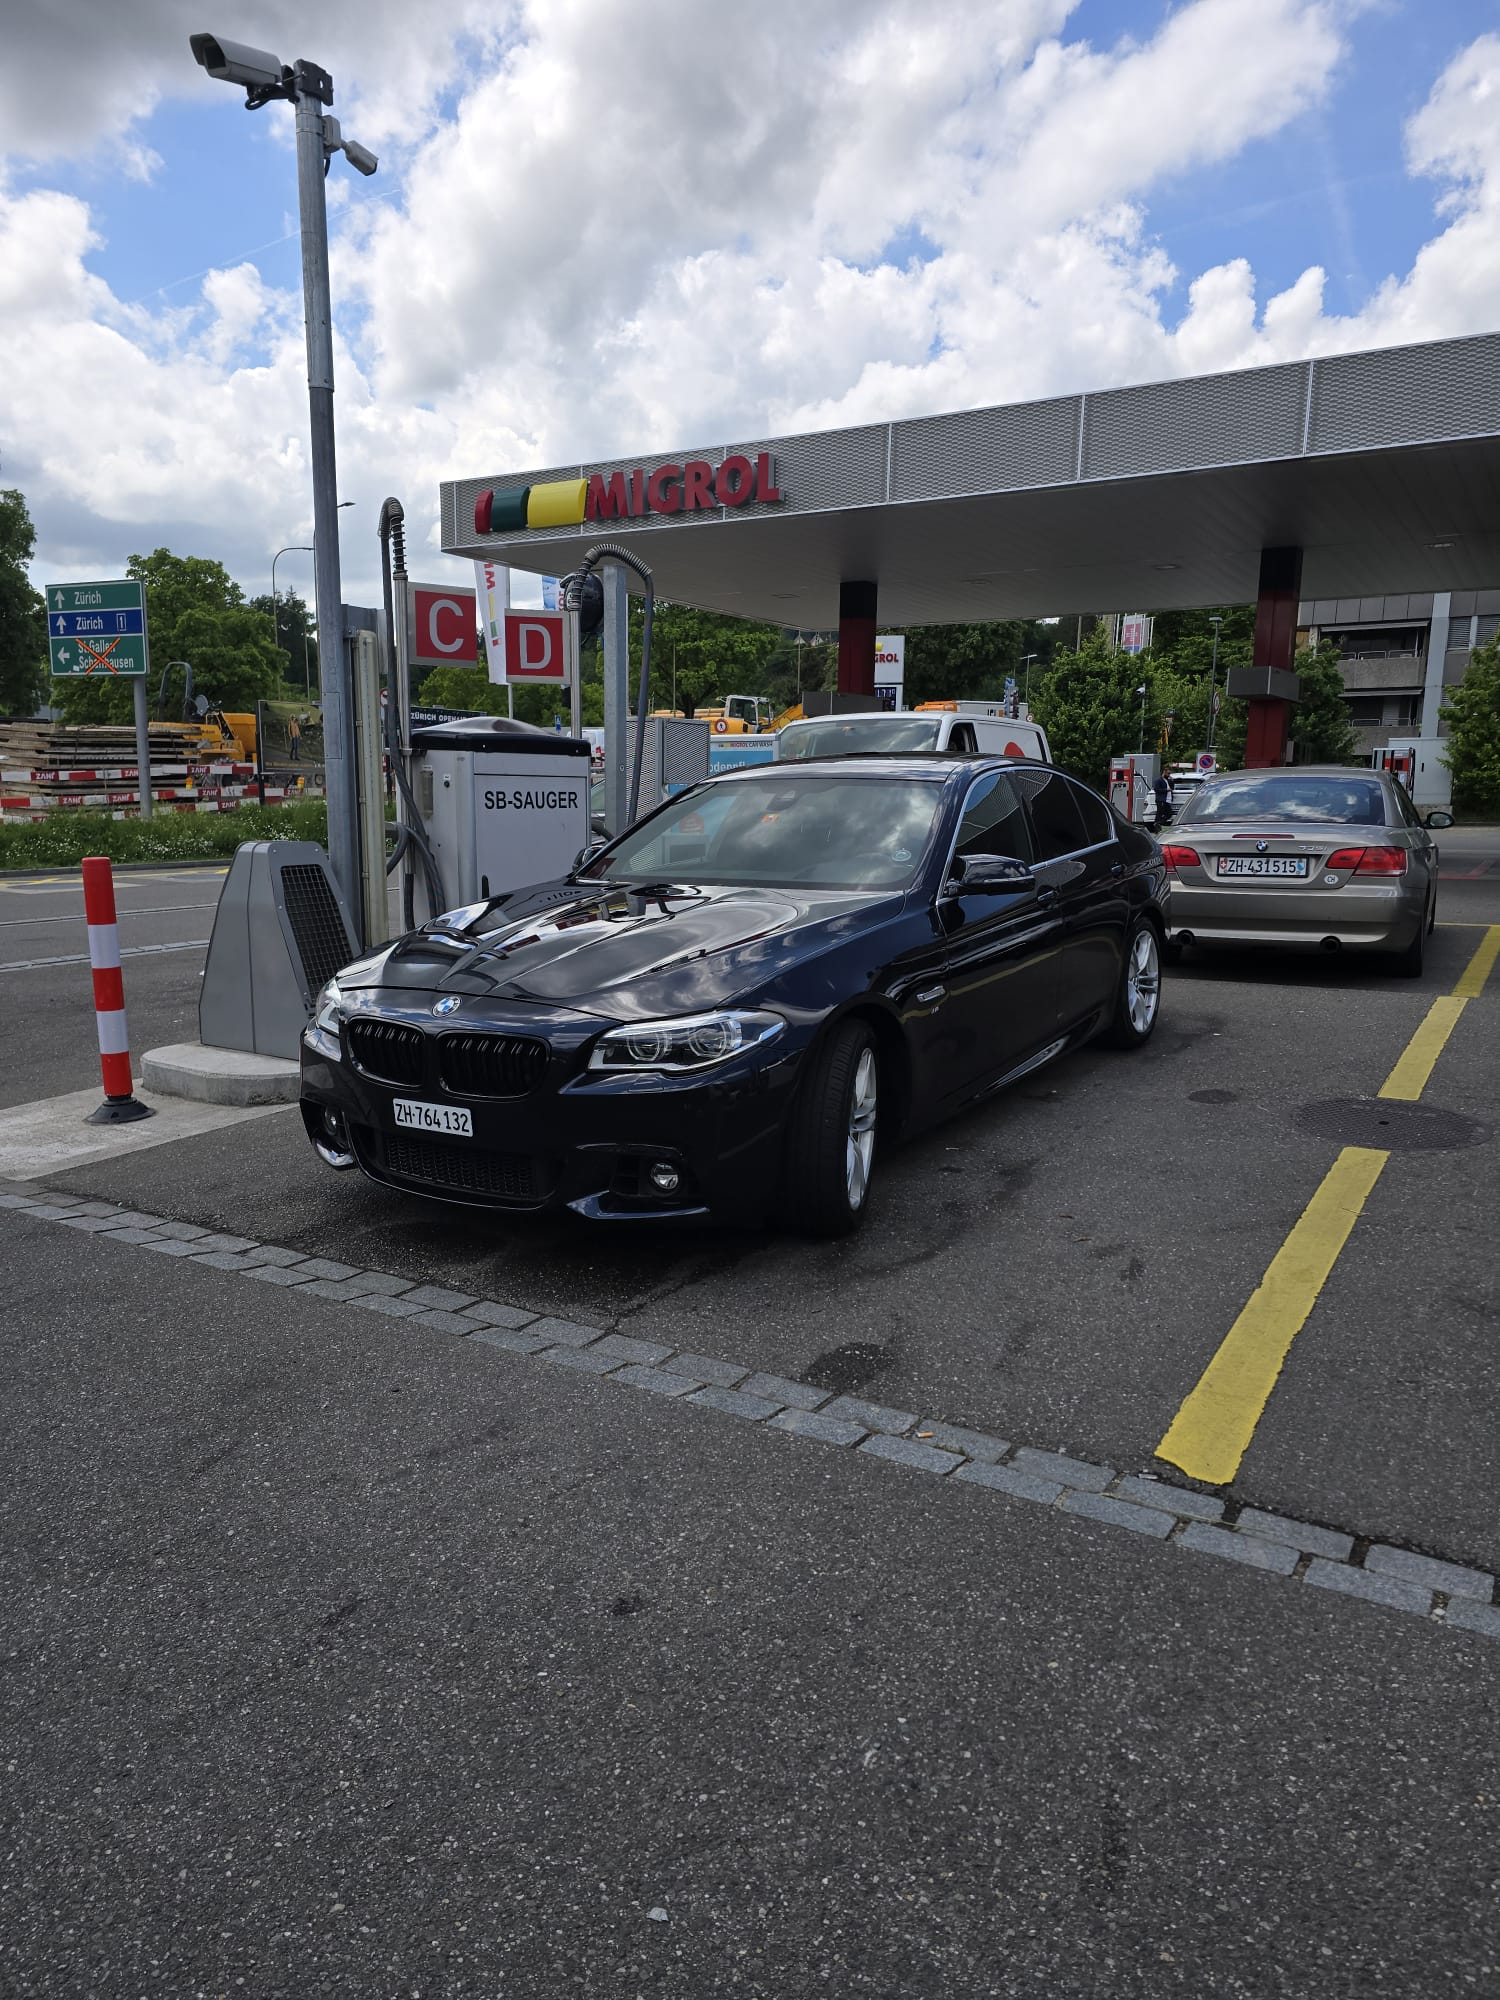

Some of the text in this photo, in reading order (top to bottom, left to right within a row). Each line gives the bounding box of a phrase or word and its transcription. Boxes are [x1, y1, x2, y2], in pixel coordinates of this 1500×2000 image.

[586, 452, 782, 521] MIGROL
[74, 590, 102, 605] Zürich
[76, 616, 103, 631] Zürich
[429, 599, 464, 653] C
[519, 623, 552, 670] D
[410, 711, 437, 721] ZÜRICH
[125, 769, 139, 777] ZAN
[484, 790, 578, 810] SB-SAUGER
